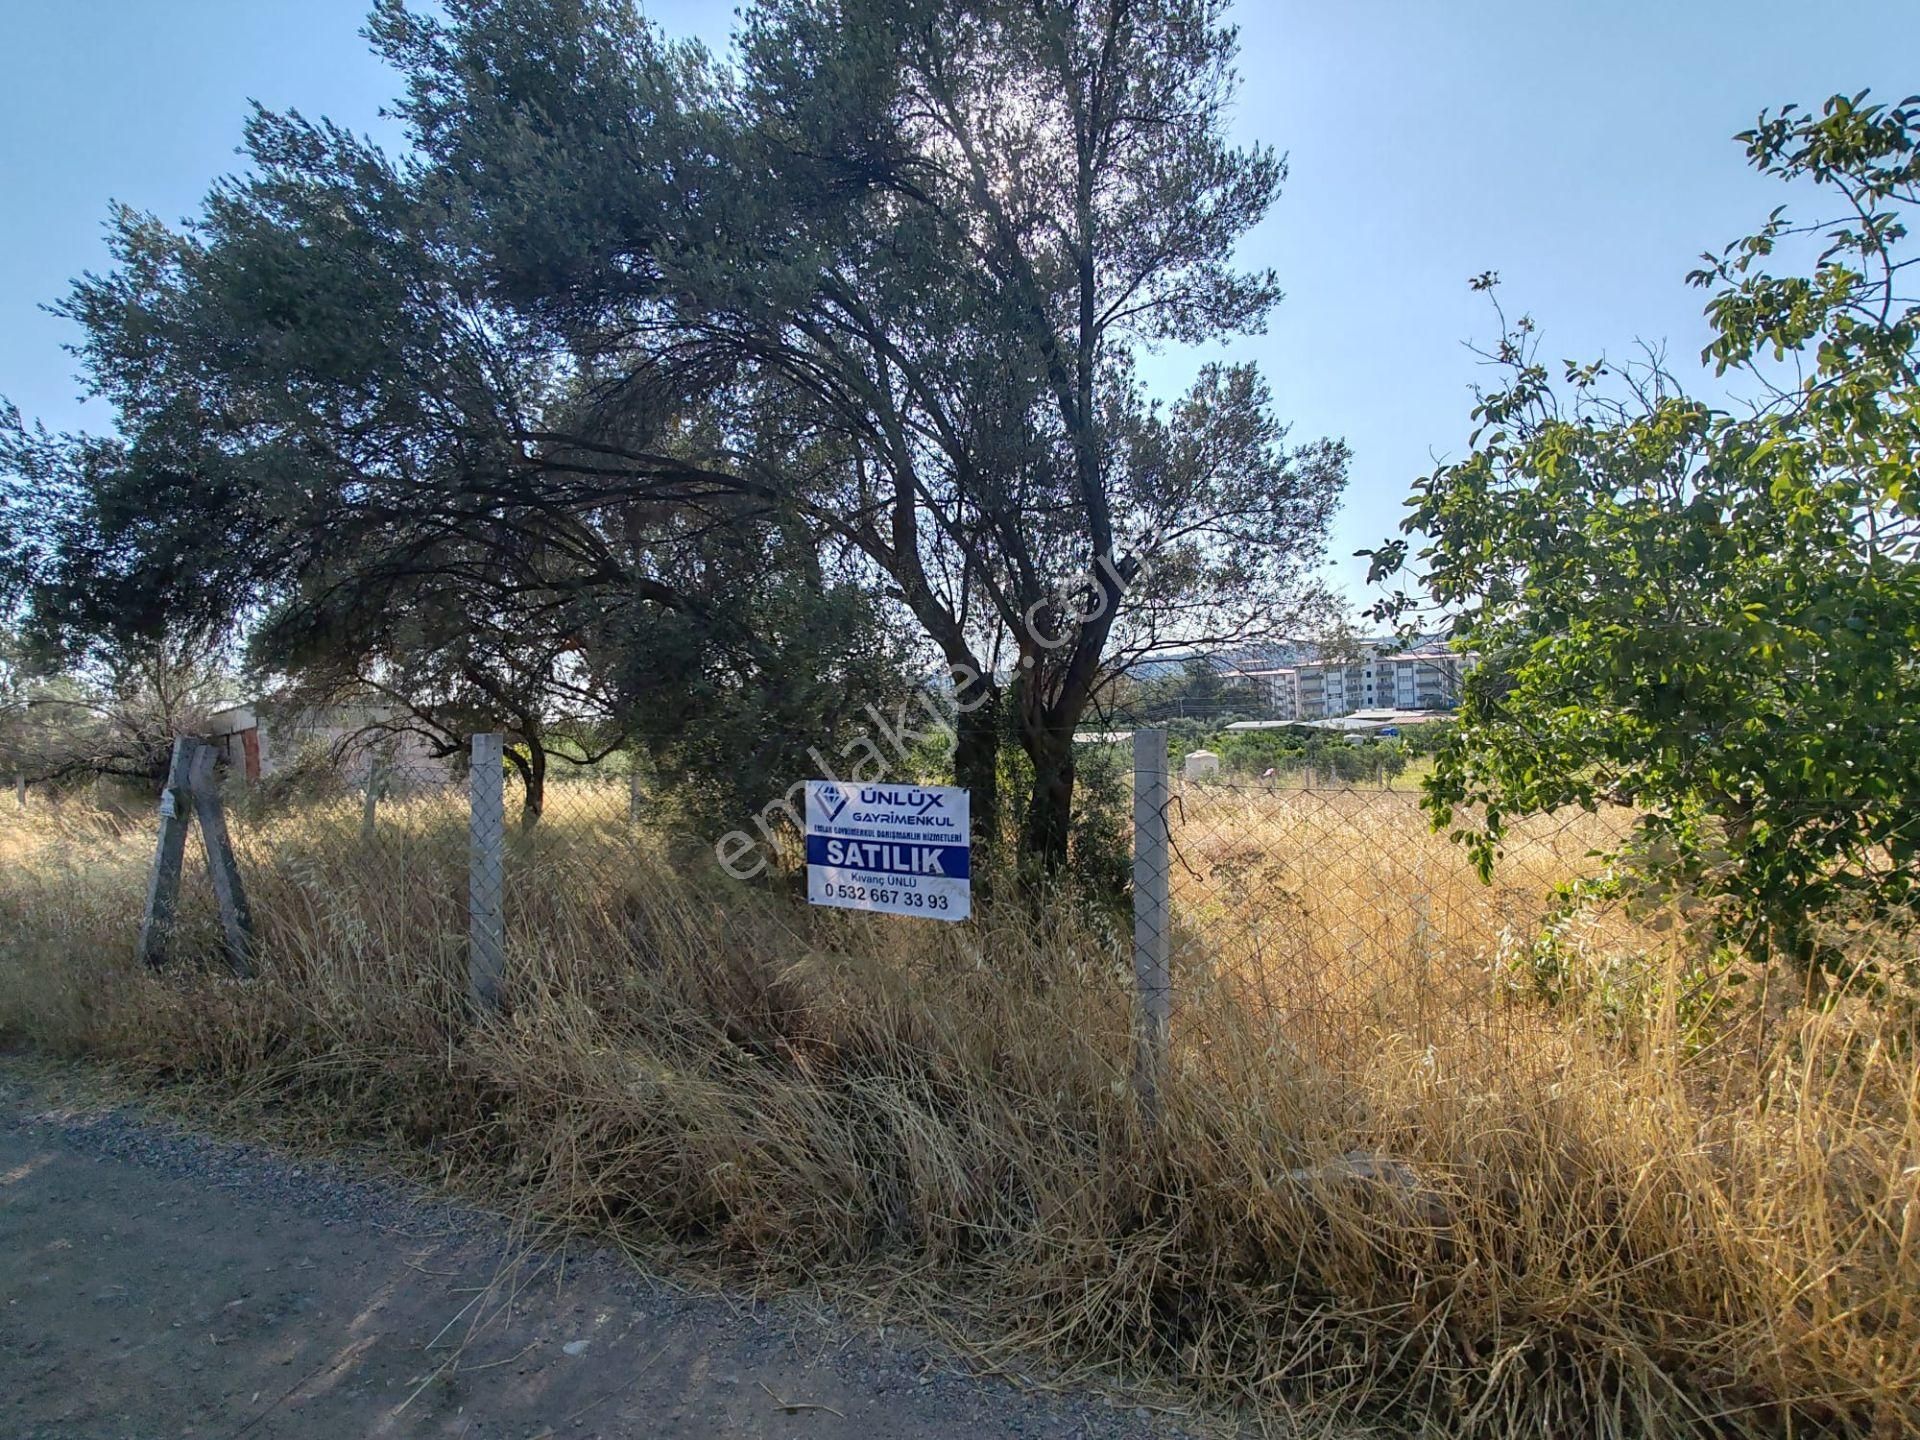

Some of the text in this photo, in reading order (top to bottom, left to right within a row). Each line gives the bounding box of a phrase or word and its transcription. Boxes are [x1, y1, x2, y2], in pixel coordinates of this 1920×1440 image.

[861, 787, 944, 815] ÜNLÜX
[853, 811, 954, 827] GAYRİMENKUL
[827, 840, 945, 875] SATILIK
[851, 872, 917, 888] Kıvanç ÜNLÜ
[825, 883, 949, 910] 0 532 667 33 93
